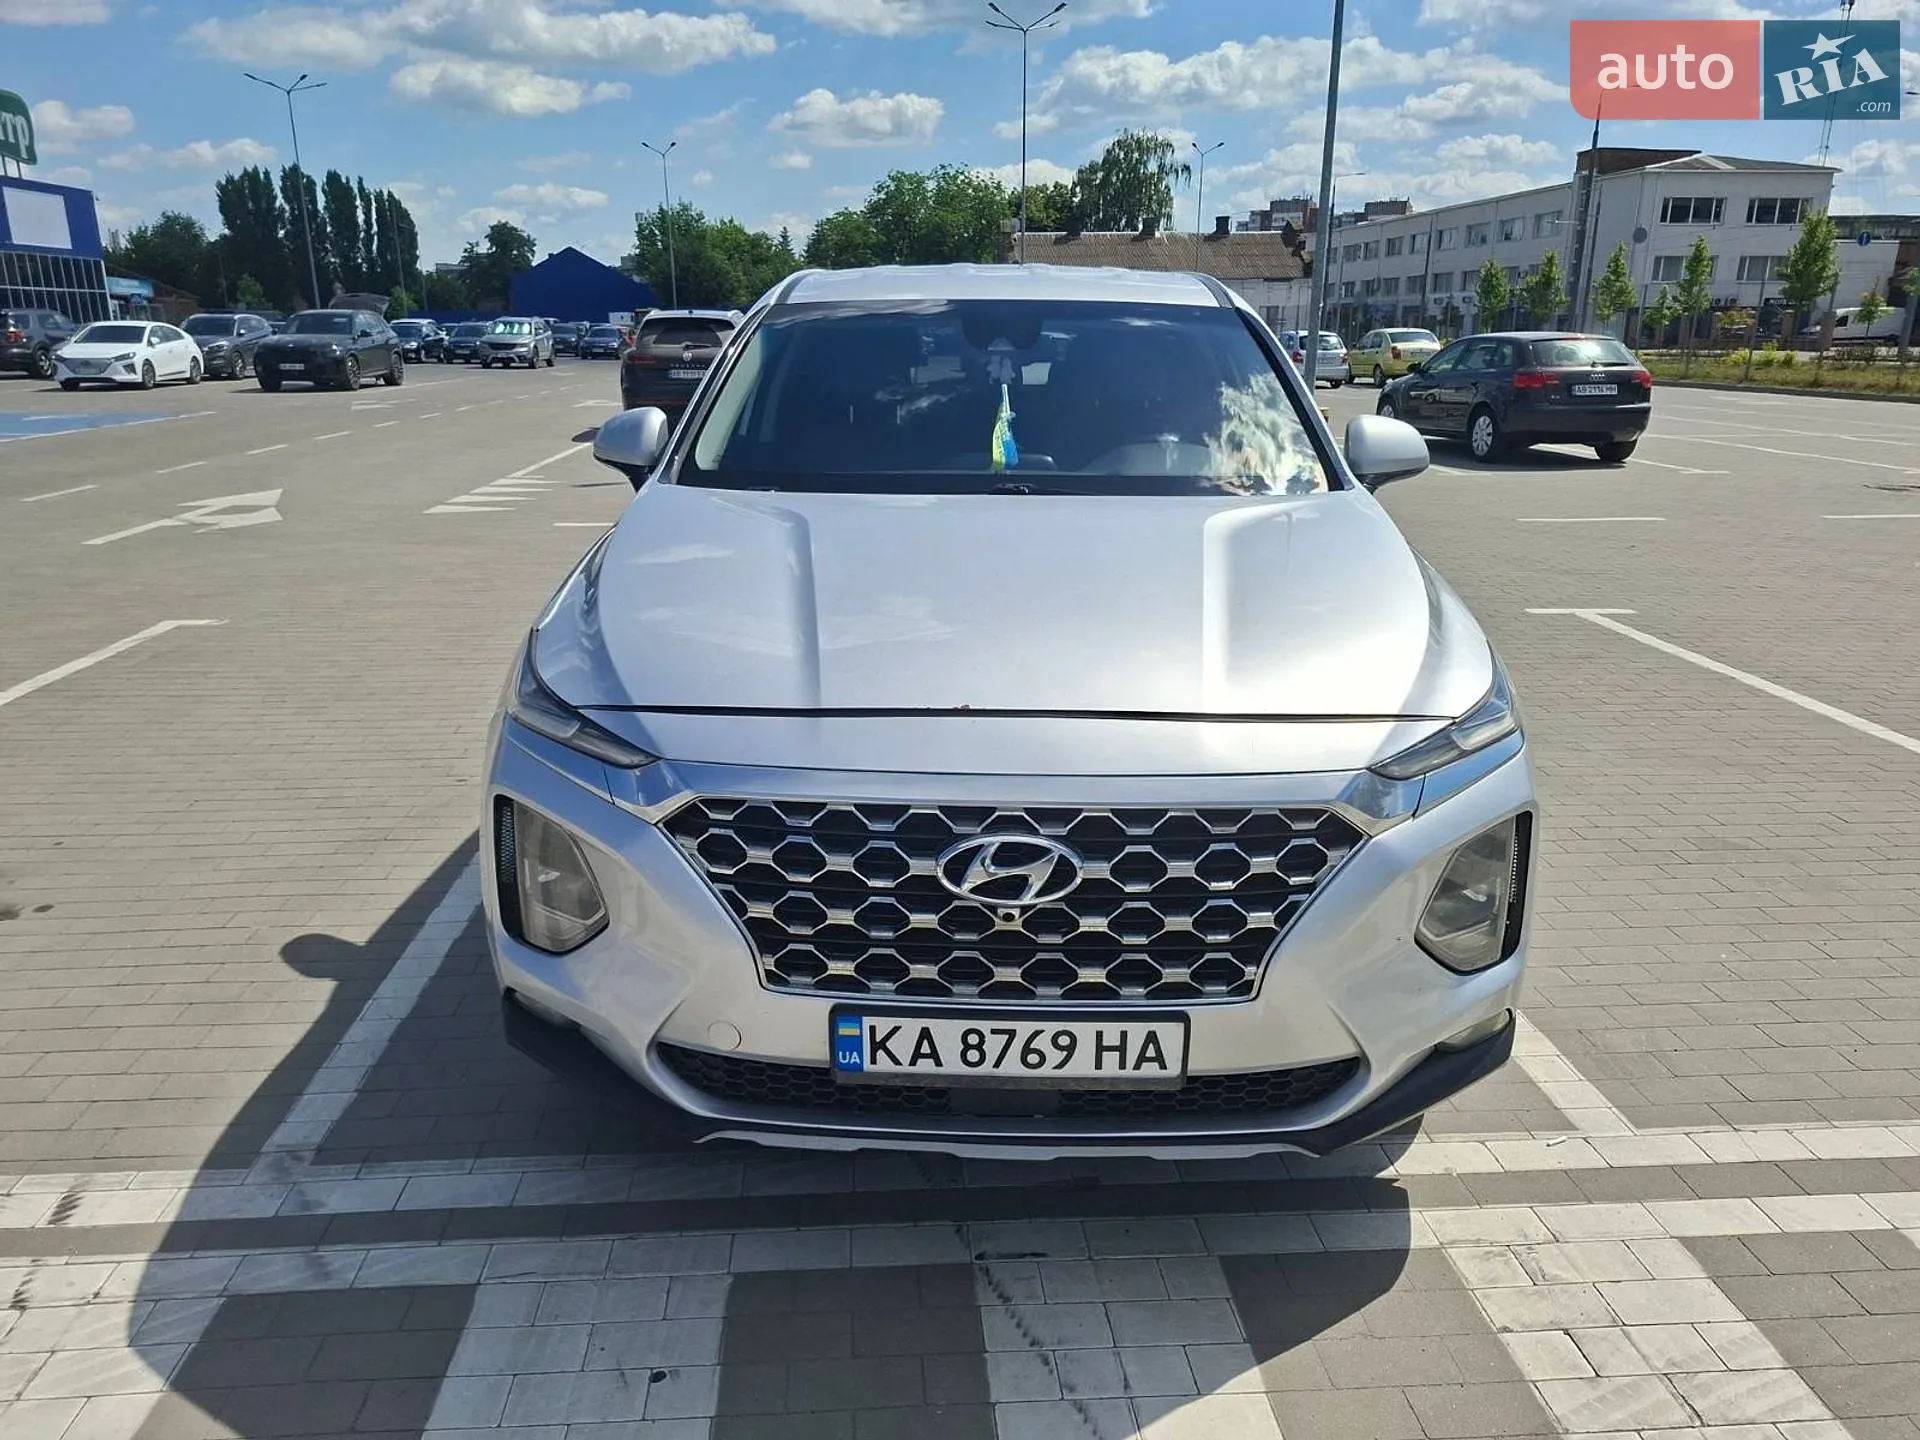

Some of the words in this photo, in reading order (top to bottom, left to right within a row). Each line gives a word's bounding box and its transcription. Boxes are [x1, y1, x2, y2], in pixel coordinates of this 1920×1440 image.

[839, 1051, 861, 1064] UA
[868, 1025, 944, 1067] KA
[959, 1028, 1078, 1069] 8769
[1094, 1030, 1169, 1070] HA
